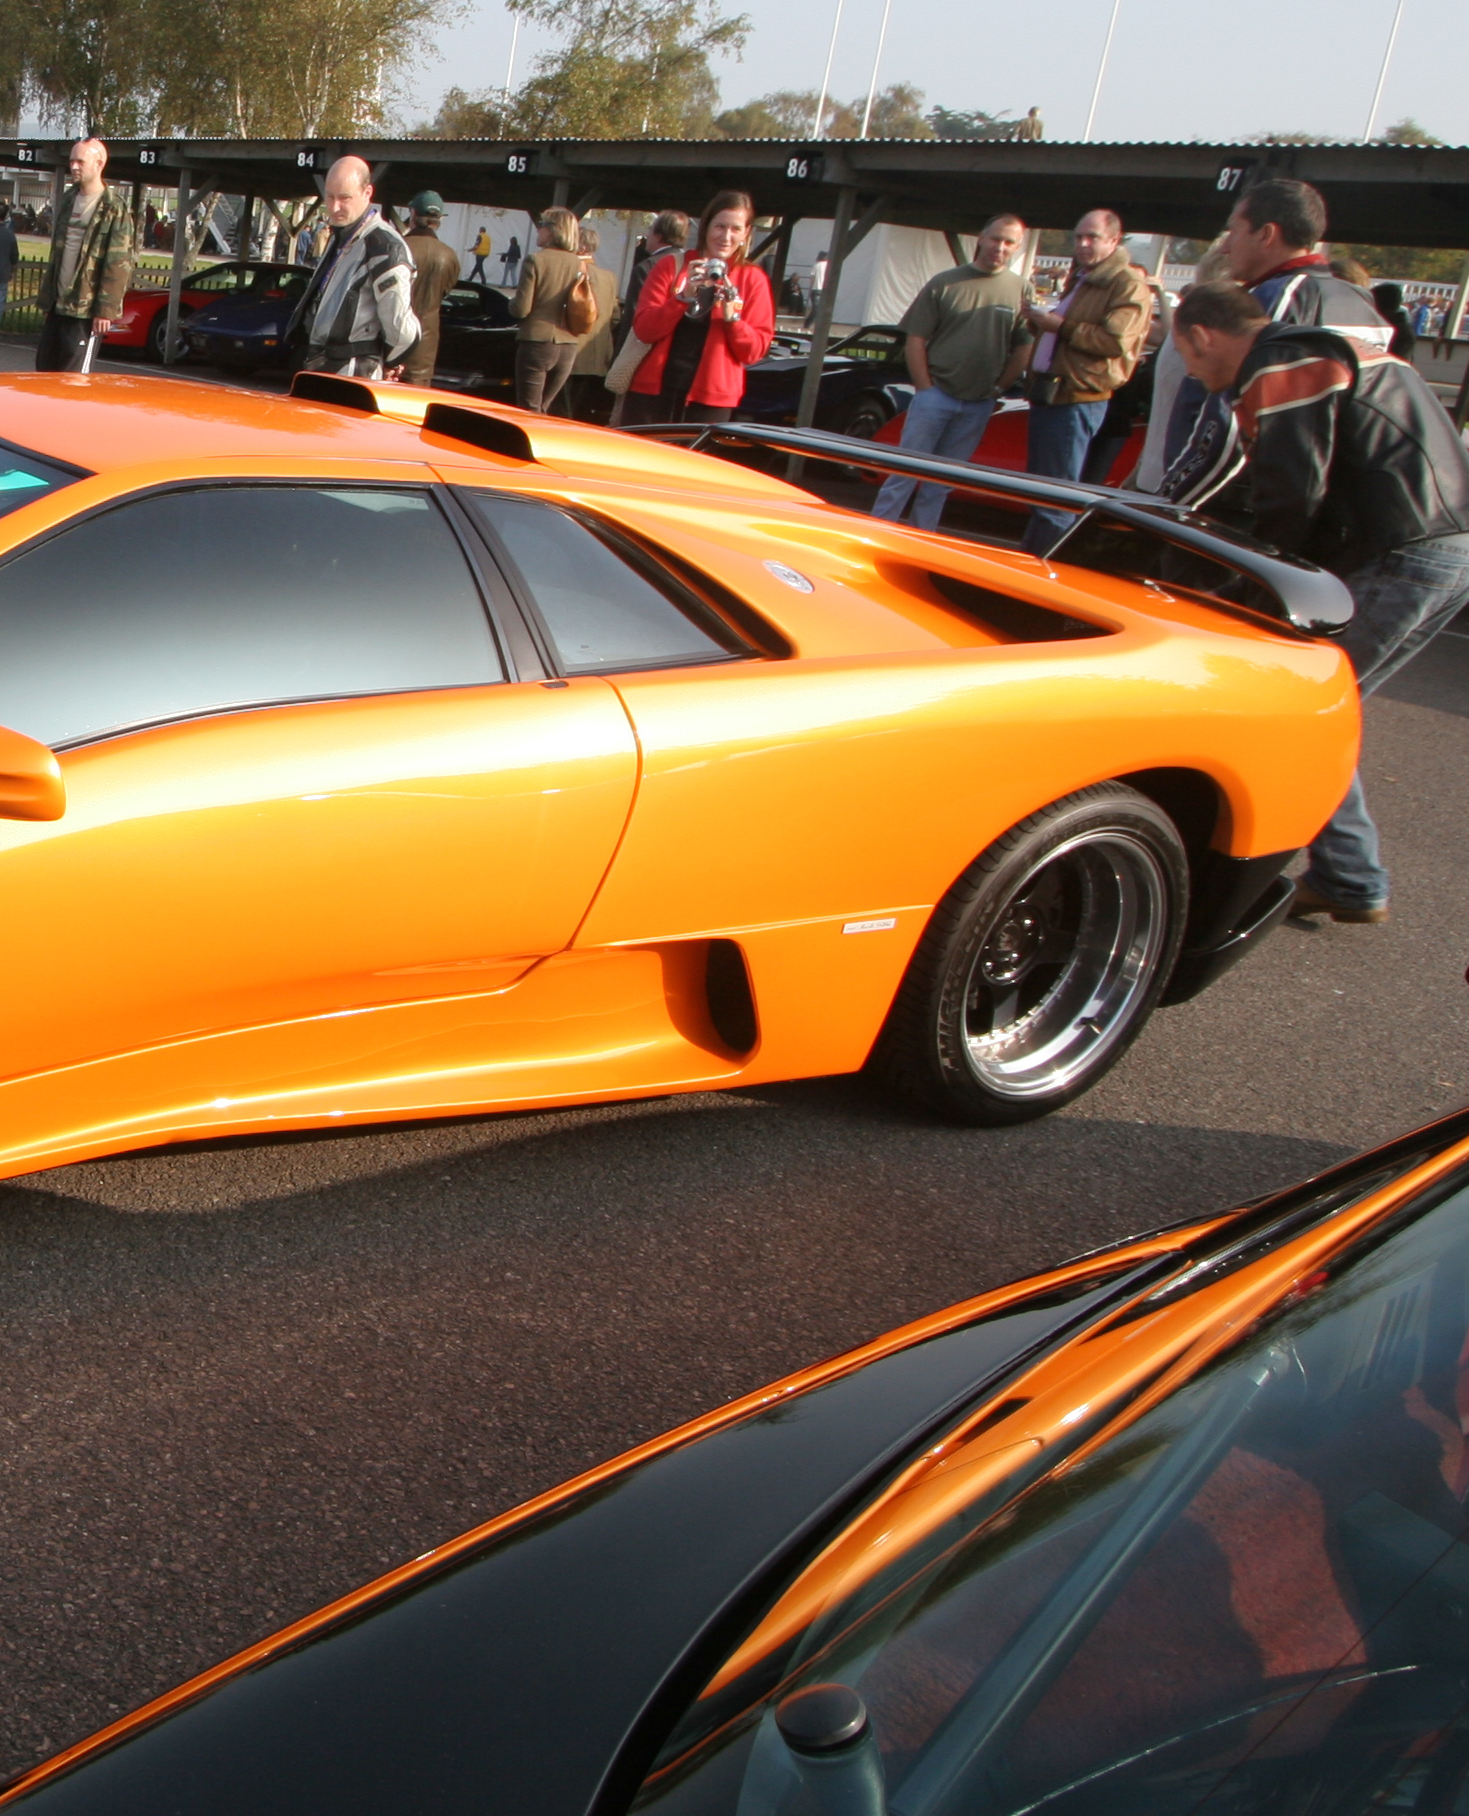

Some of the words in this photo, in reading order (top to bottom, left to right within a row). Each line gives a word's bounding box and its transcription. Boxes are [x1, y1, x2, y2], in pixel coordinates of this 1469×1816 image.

[18, 149, 33, 161] 82
[139, 151, 155, 164] 83
[297, 152, 314, 167] 84
[508, 155, 527, 172] 85
[787, 158, 808, 178] 86
[1216, 167, 1243, 191] 87
